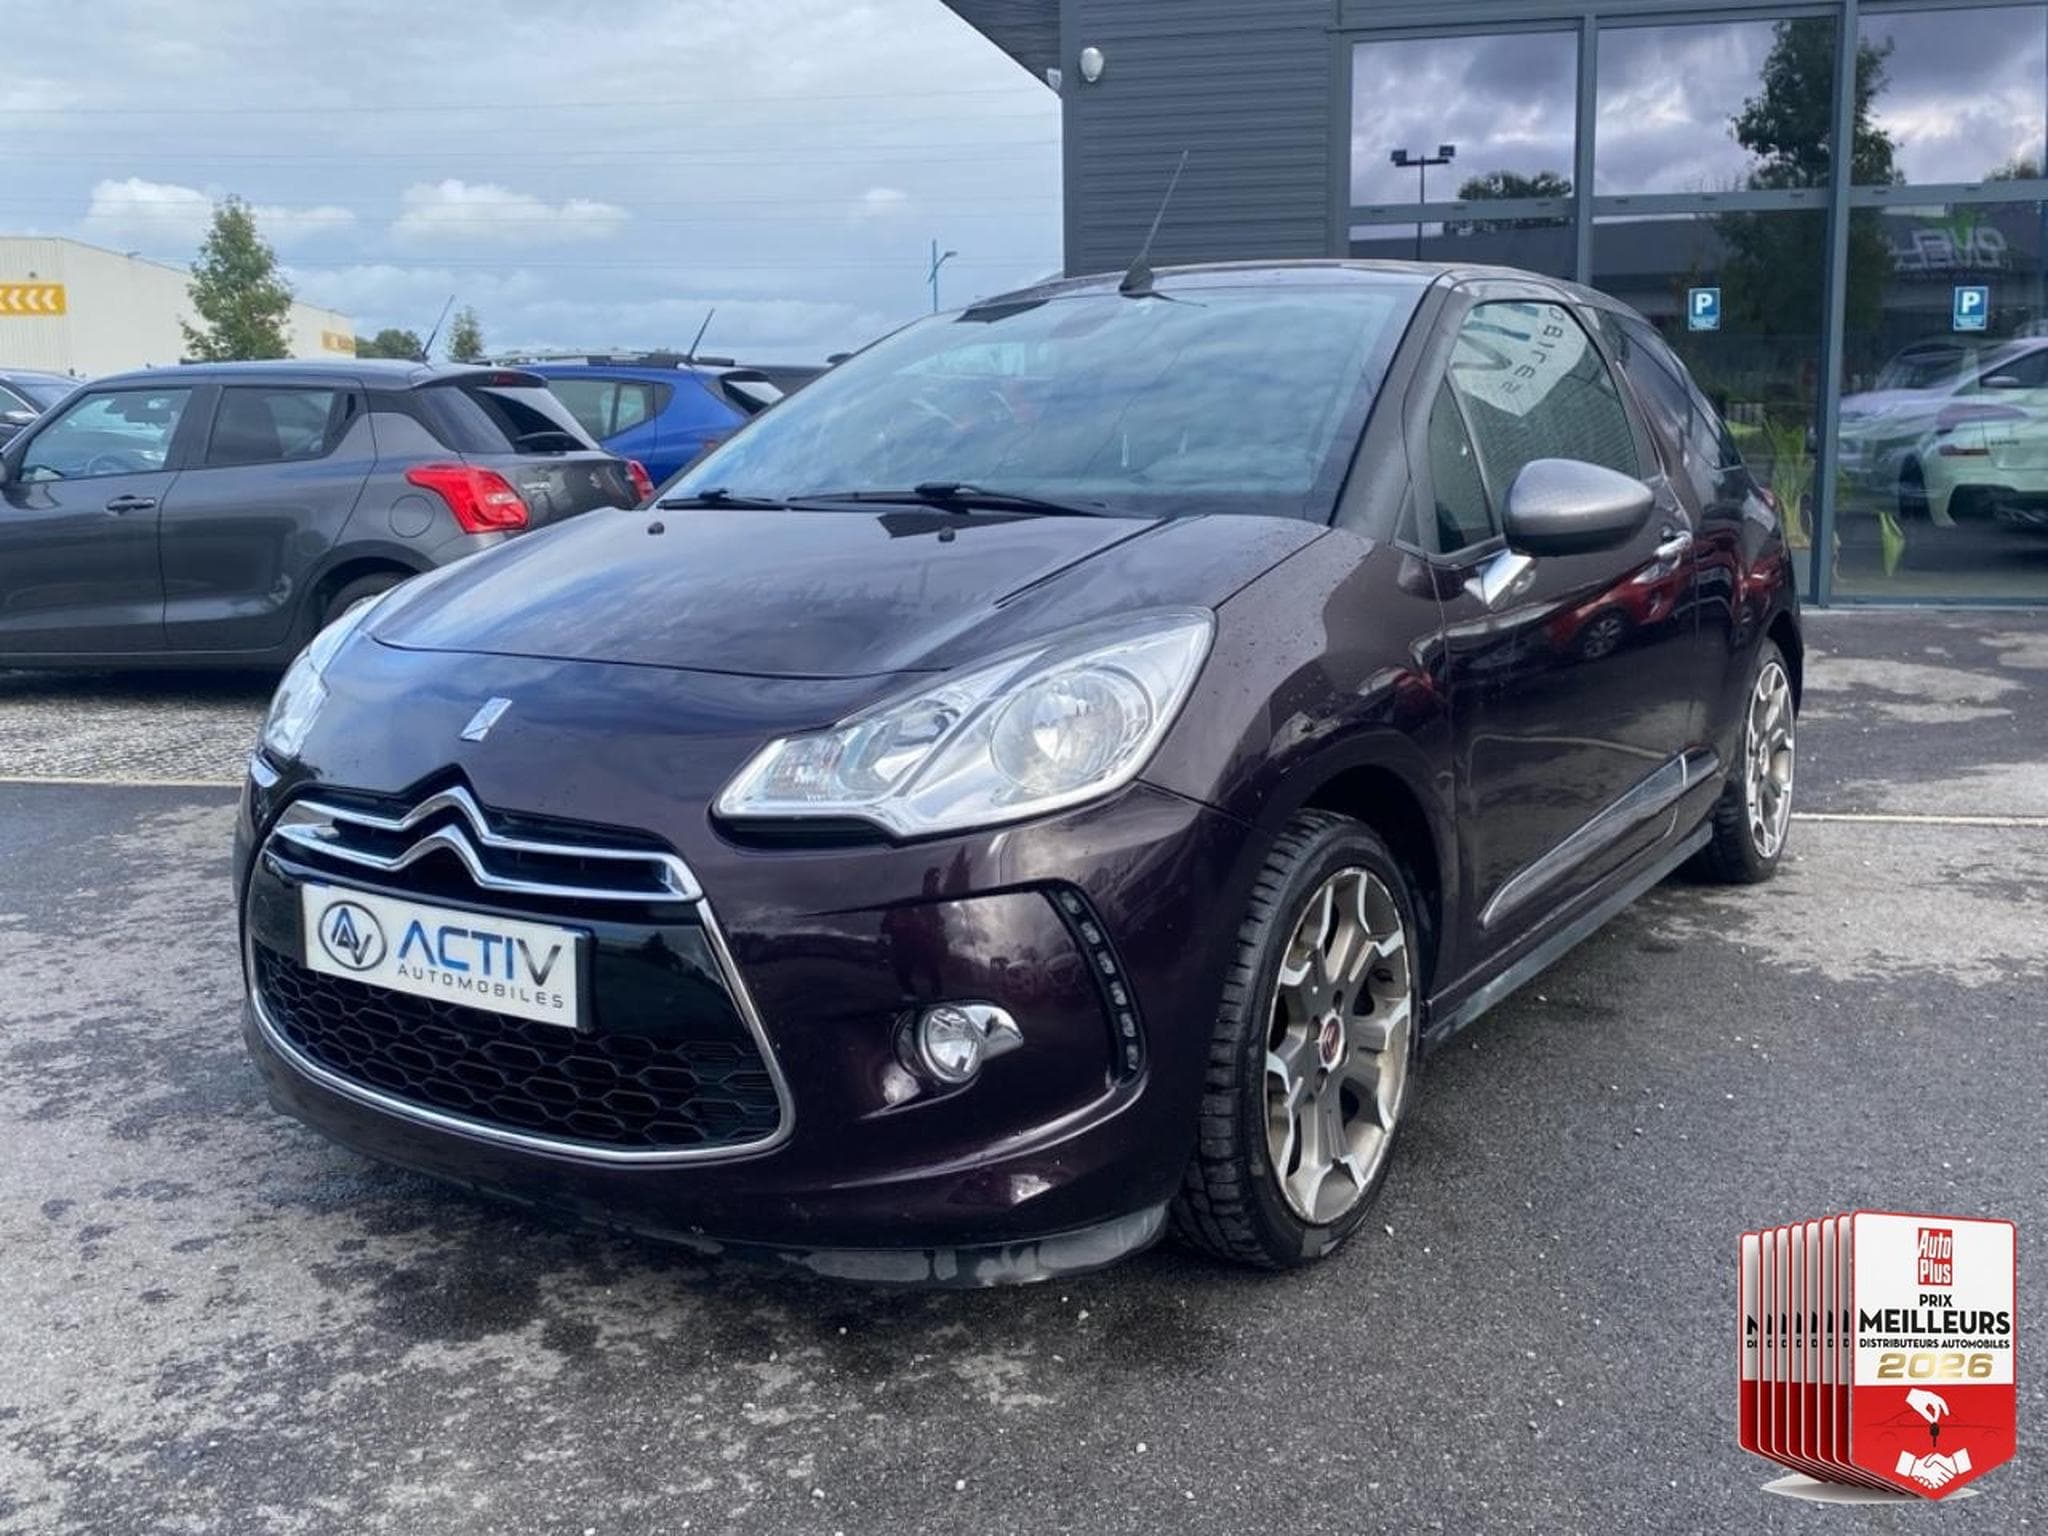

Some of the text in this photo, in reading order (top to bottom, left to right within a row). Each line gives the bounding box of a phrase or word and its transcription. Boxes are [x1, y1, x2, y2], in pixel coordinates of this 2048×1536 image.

[1695, 293, 1713, 315] P
[1962, 291, 1981, 314] P
[397, 919, 562, 987] ACTIV
[397, 962, 565, 1009] AUTOMOBILES
